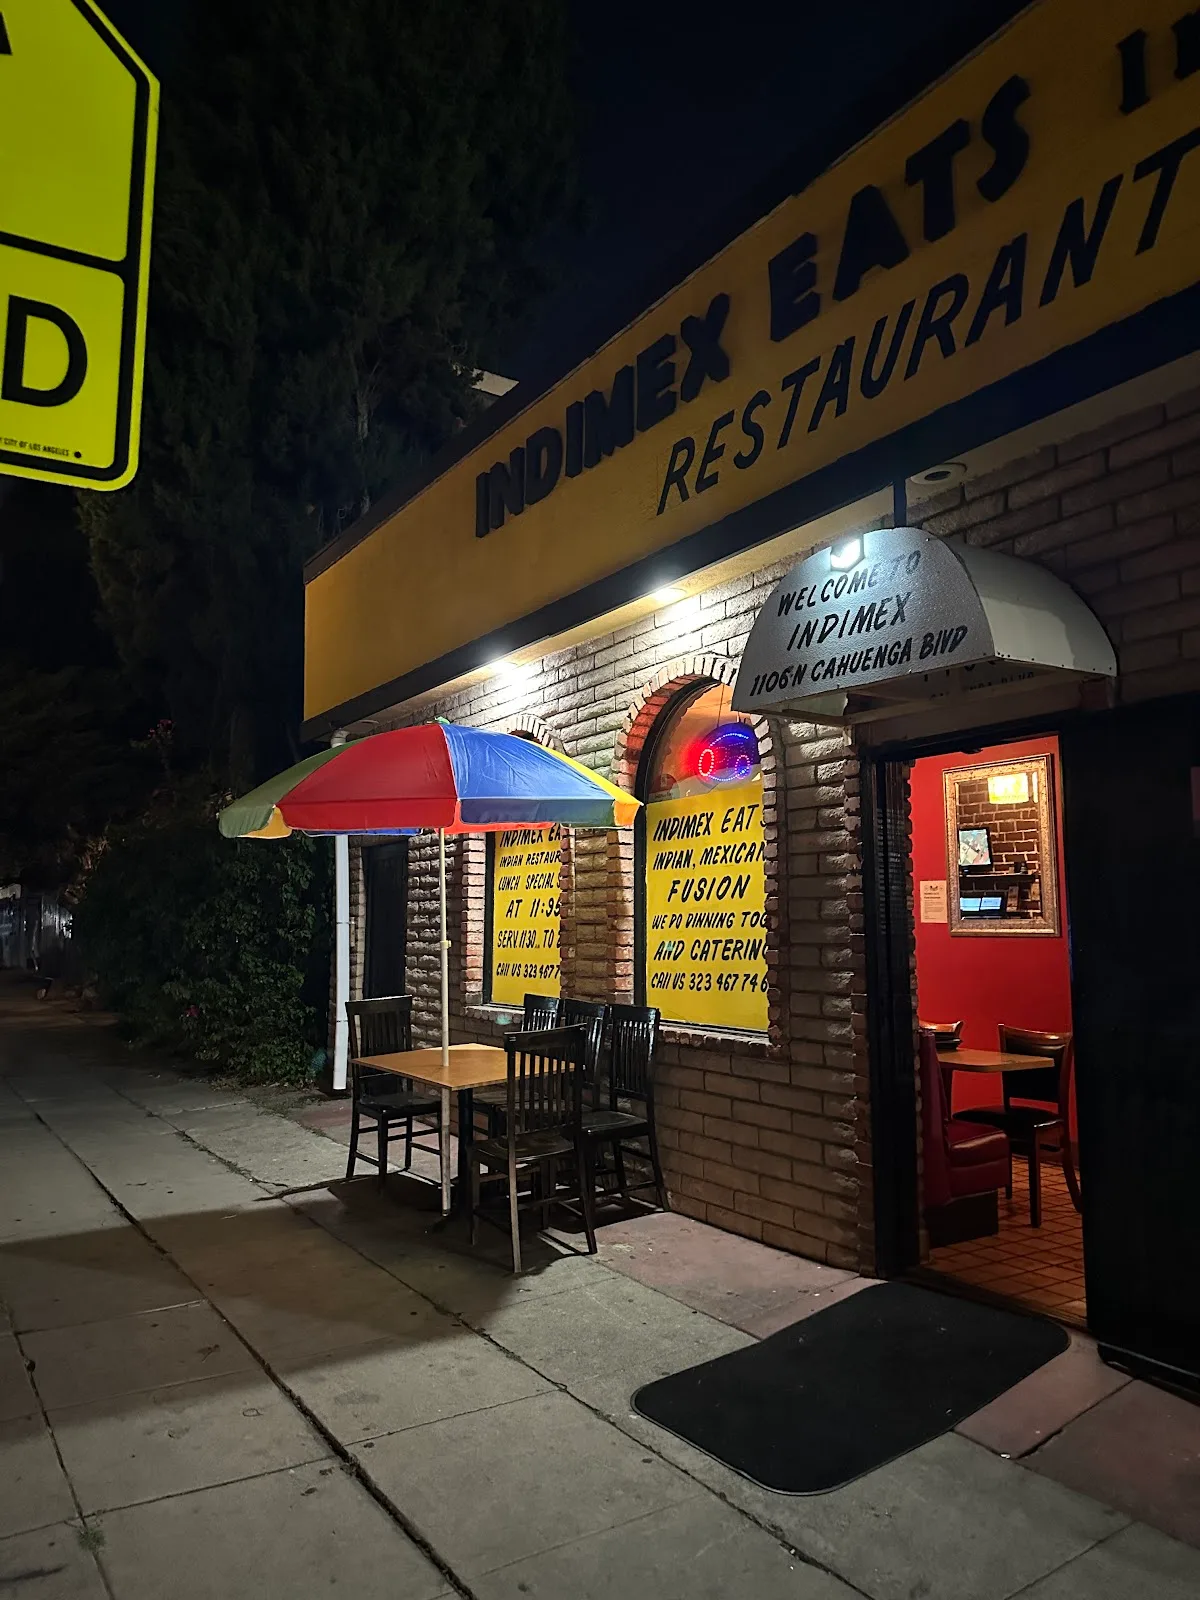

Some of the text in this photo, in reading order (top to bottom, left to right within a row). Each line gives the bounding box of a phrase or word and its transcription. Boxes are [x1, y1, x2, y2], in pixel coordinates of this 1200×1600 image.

[476, 293, 731, 538] INDIMEX
[768, 73, 1032, 343] EATS
[656, 126, 1200, 516] RESTAURANT
[777, 549, 922, 617] WELCOME TO
[786, 591, 912, 651] INDIMEX
[811, 637, 912, 683] CAHUENGA
[653, 811, 715, 842] INDIMEX
[500, 829, 543, 847] INDIMEX
[500, 854, 524, 868] INDIAN
[653, 848, 696, 870] INDIAN,
[498, 875, 521, 891] LUNCH
[525, 872, 555, 890] SPECIAL
[667, 874, 751, 903] FUSION
[506, 899, 523, 918] AT
[652, 914, 668, 930] WE
[543, 928, 555, 949] TO
[653, 940, 685, 961] AND
[511, 963, 522, 978] US
[524, 963, 538, 979] 323
[672, 972, 686, 990] US
[688, 972, 712, 992] 323
[716, 972, 739, 992] 467
